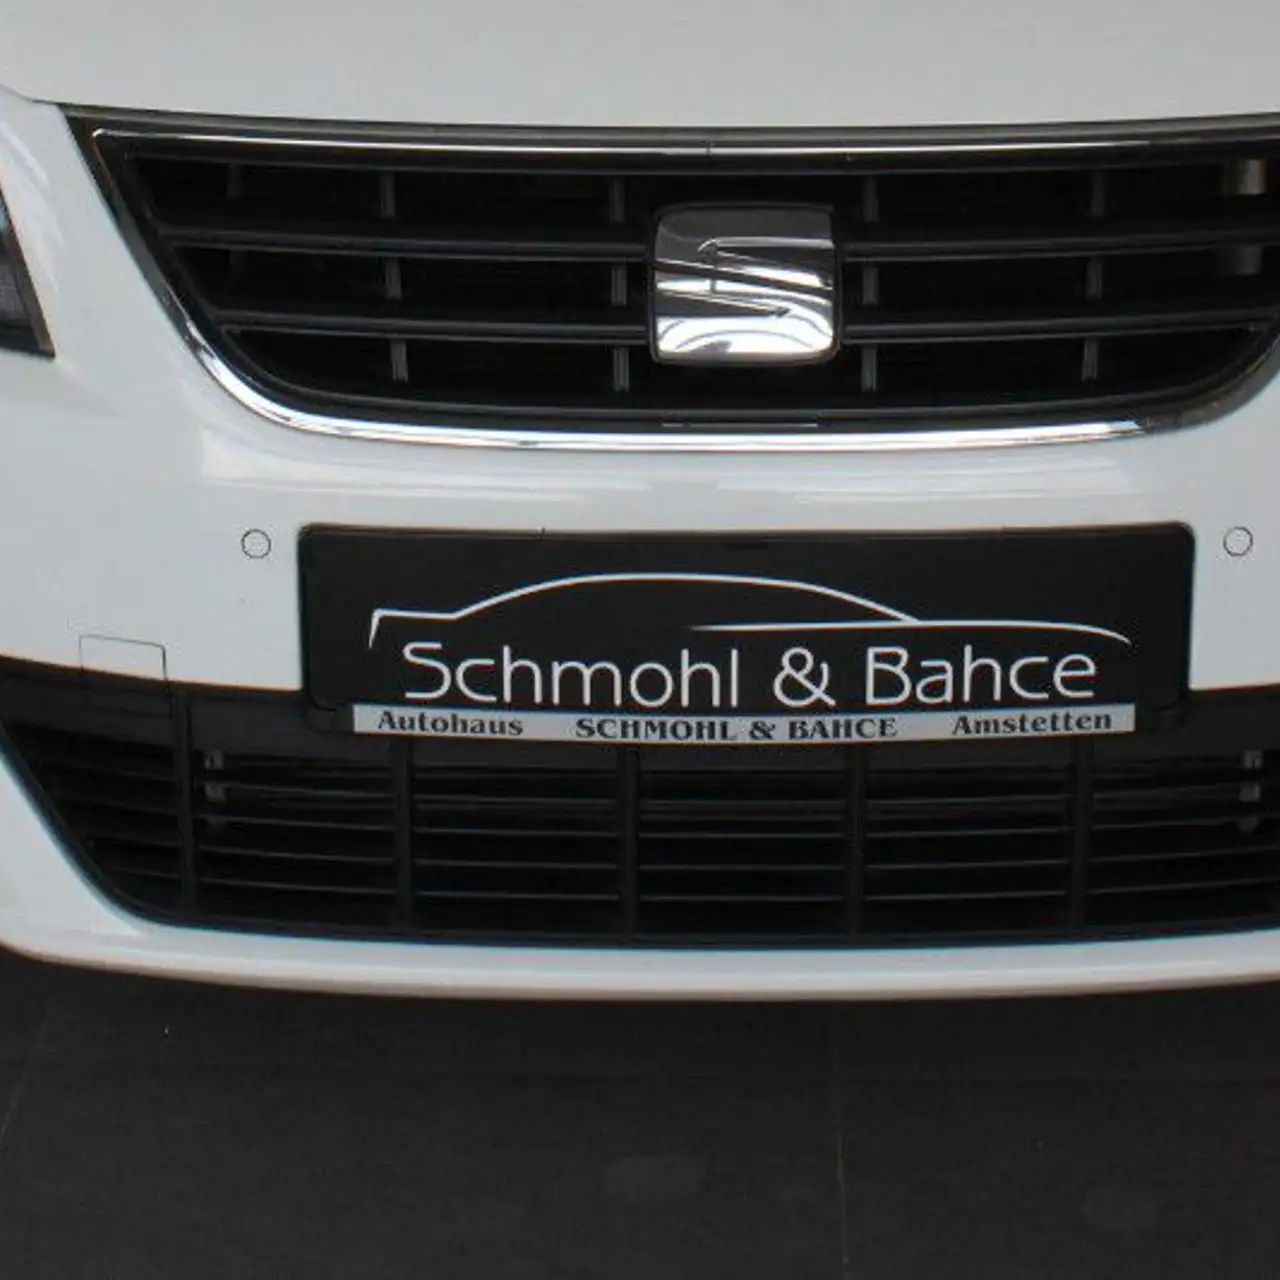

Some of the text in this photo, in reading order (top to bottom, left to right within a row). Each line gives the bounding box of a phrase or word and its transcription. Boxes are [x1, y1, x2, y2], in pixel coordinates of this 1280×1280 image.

[402, 640, 1098, 709] Schmohl & Bahce
[377, 708, 1114, 742] Autohaus SCHMOHL & BAHCE Amstetten
